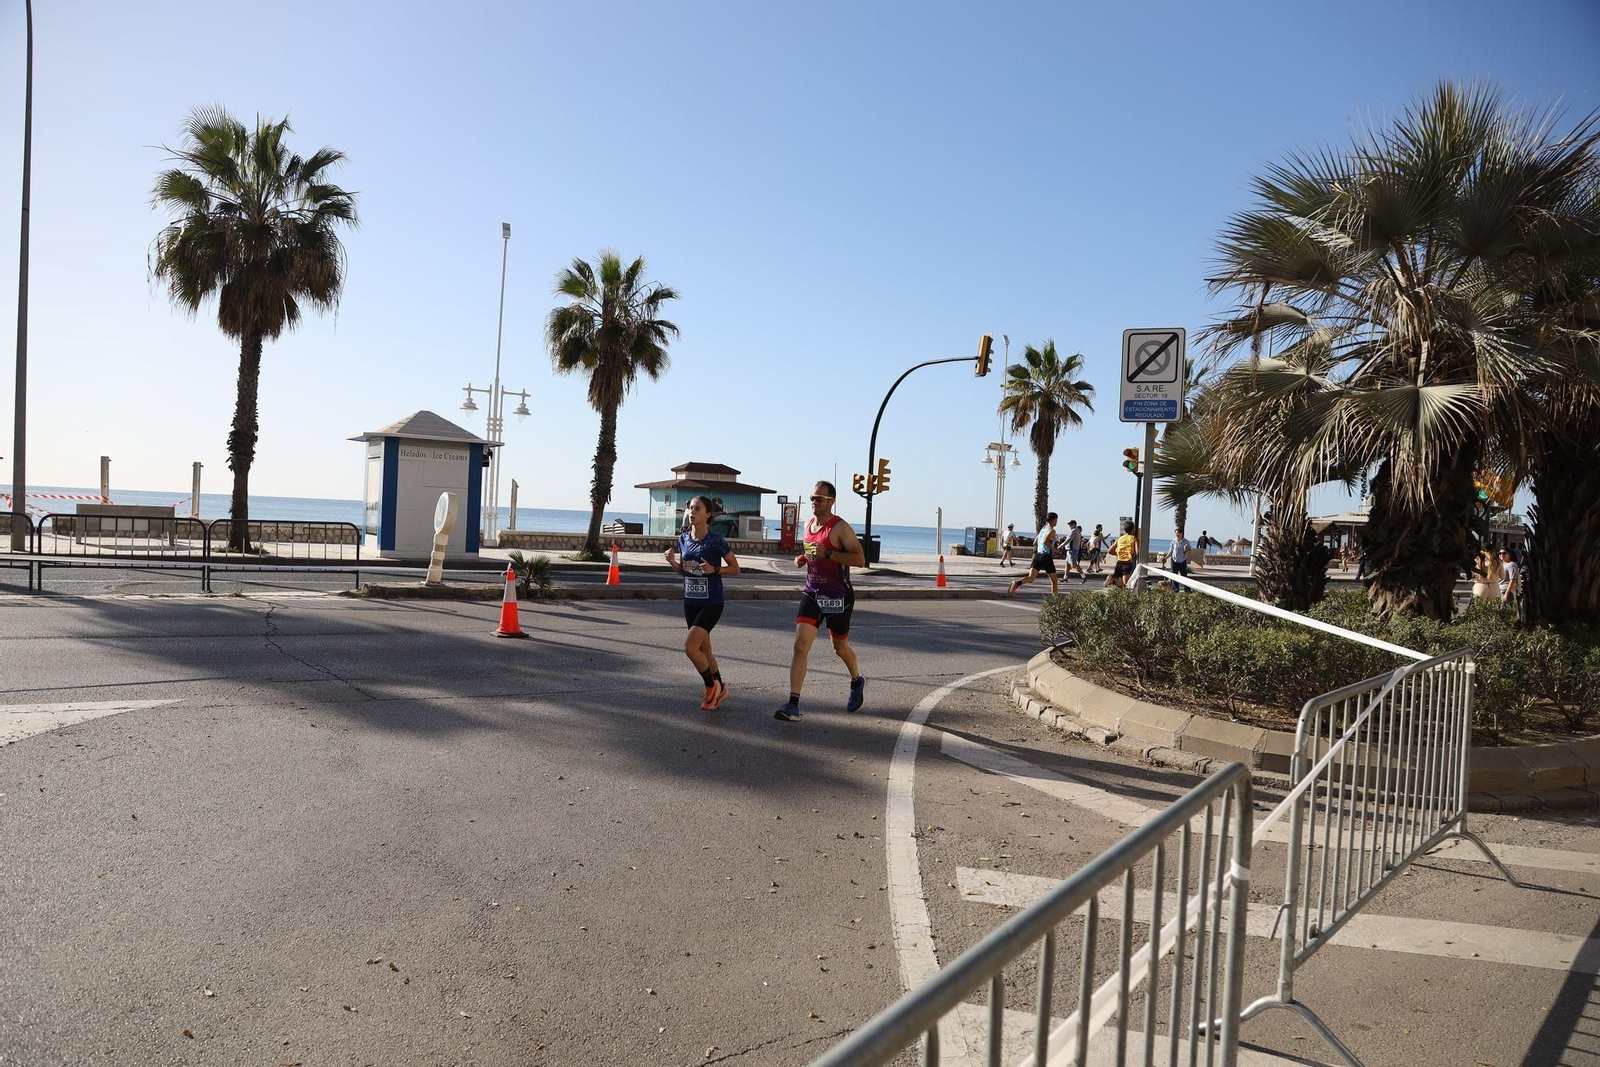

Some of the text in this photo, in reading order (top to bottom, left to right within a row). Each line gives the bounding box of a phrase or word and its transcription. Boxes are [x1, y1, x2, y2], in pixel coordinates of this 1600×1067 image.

[400, 449, 427, 458] Helados
[432, 451, 443, 460] Ice
[444, 452, 468, 461] Creams
